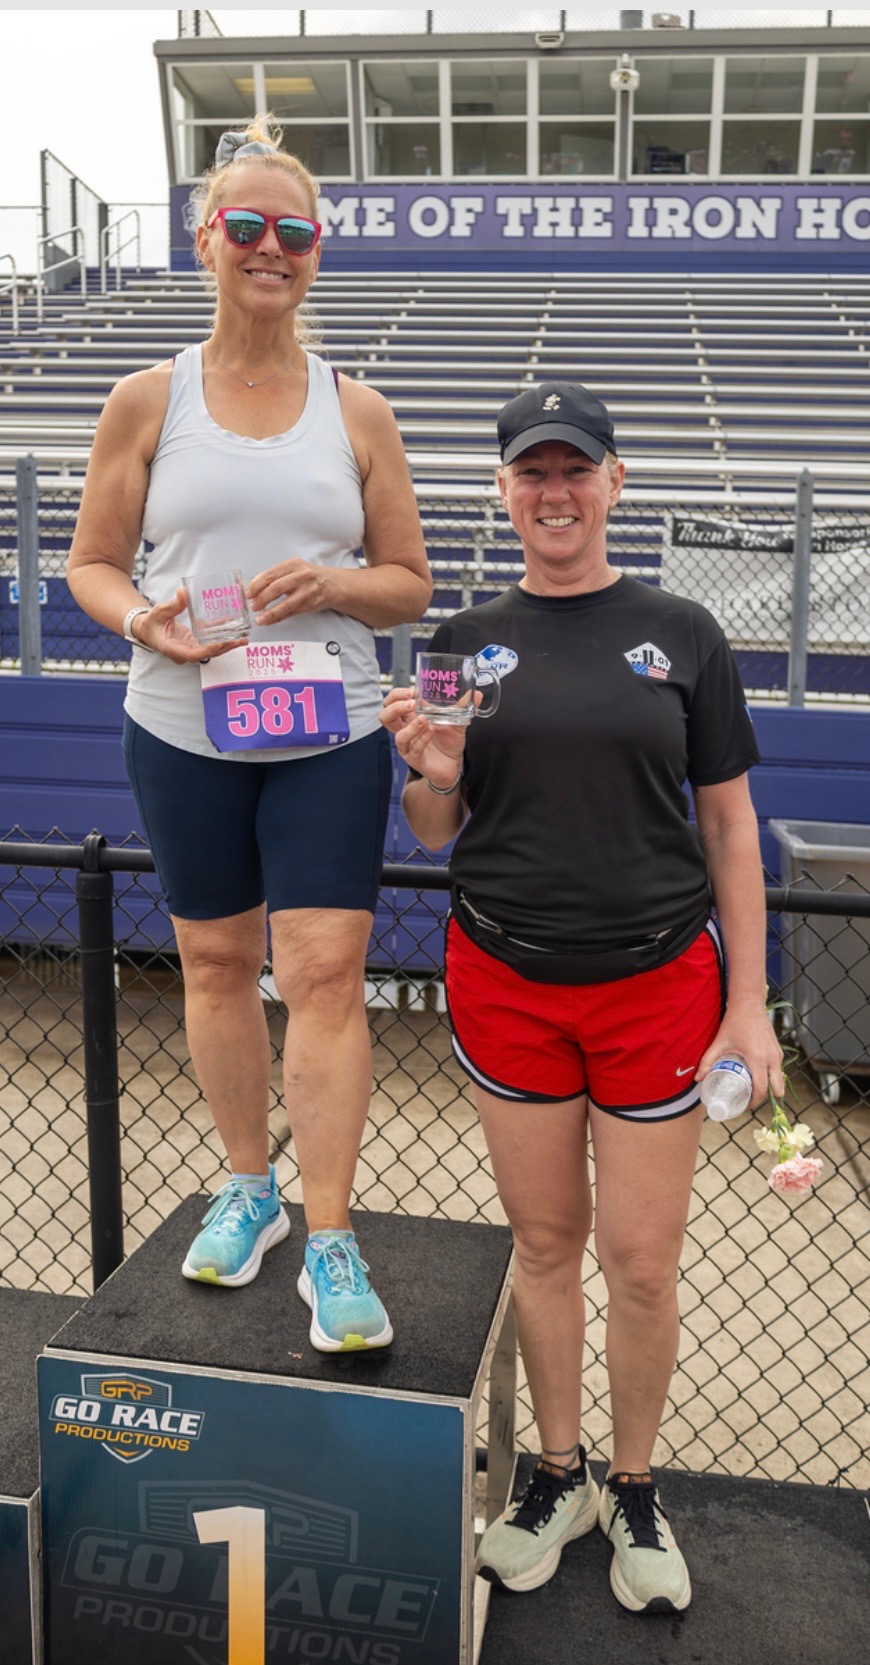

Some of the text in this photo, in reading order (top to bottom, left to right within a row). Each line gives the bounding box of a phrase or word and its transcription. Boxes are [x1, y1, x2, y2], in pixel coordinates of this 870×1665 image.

[317, 197, 396, 237] ME
[409, 196, 483, 238] OF
[496, 197, 613, 237] THE
[627, 196, 782, 239] IRON
[677, 522, 735, 546] Thank
[740, 530, 781, 547] You
[203, 599, 229, 611] RUN
[247, 657, 275, 669] RUN
[226, 686, 319, 737] 581
[100, 1379, 153, 1401] GRP
[54, 1396, 201, 1436] GO RACE
[54, 1422, 190, 1452] PRODUCTIONS
[74, 1534, 184, 1594] GO
[193, 1505, 265, 1665] 1
[73, 1595, 401, 1665] PRODUTIONS
